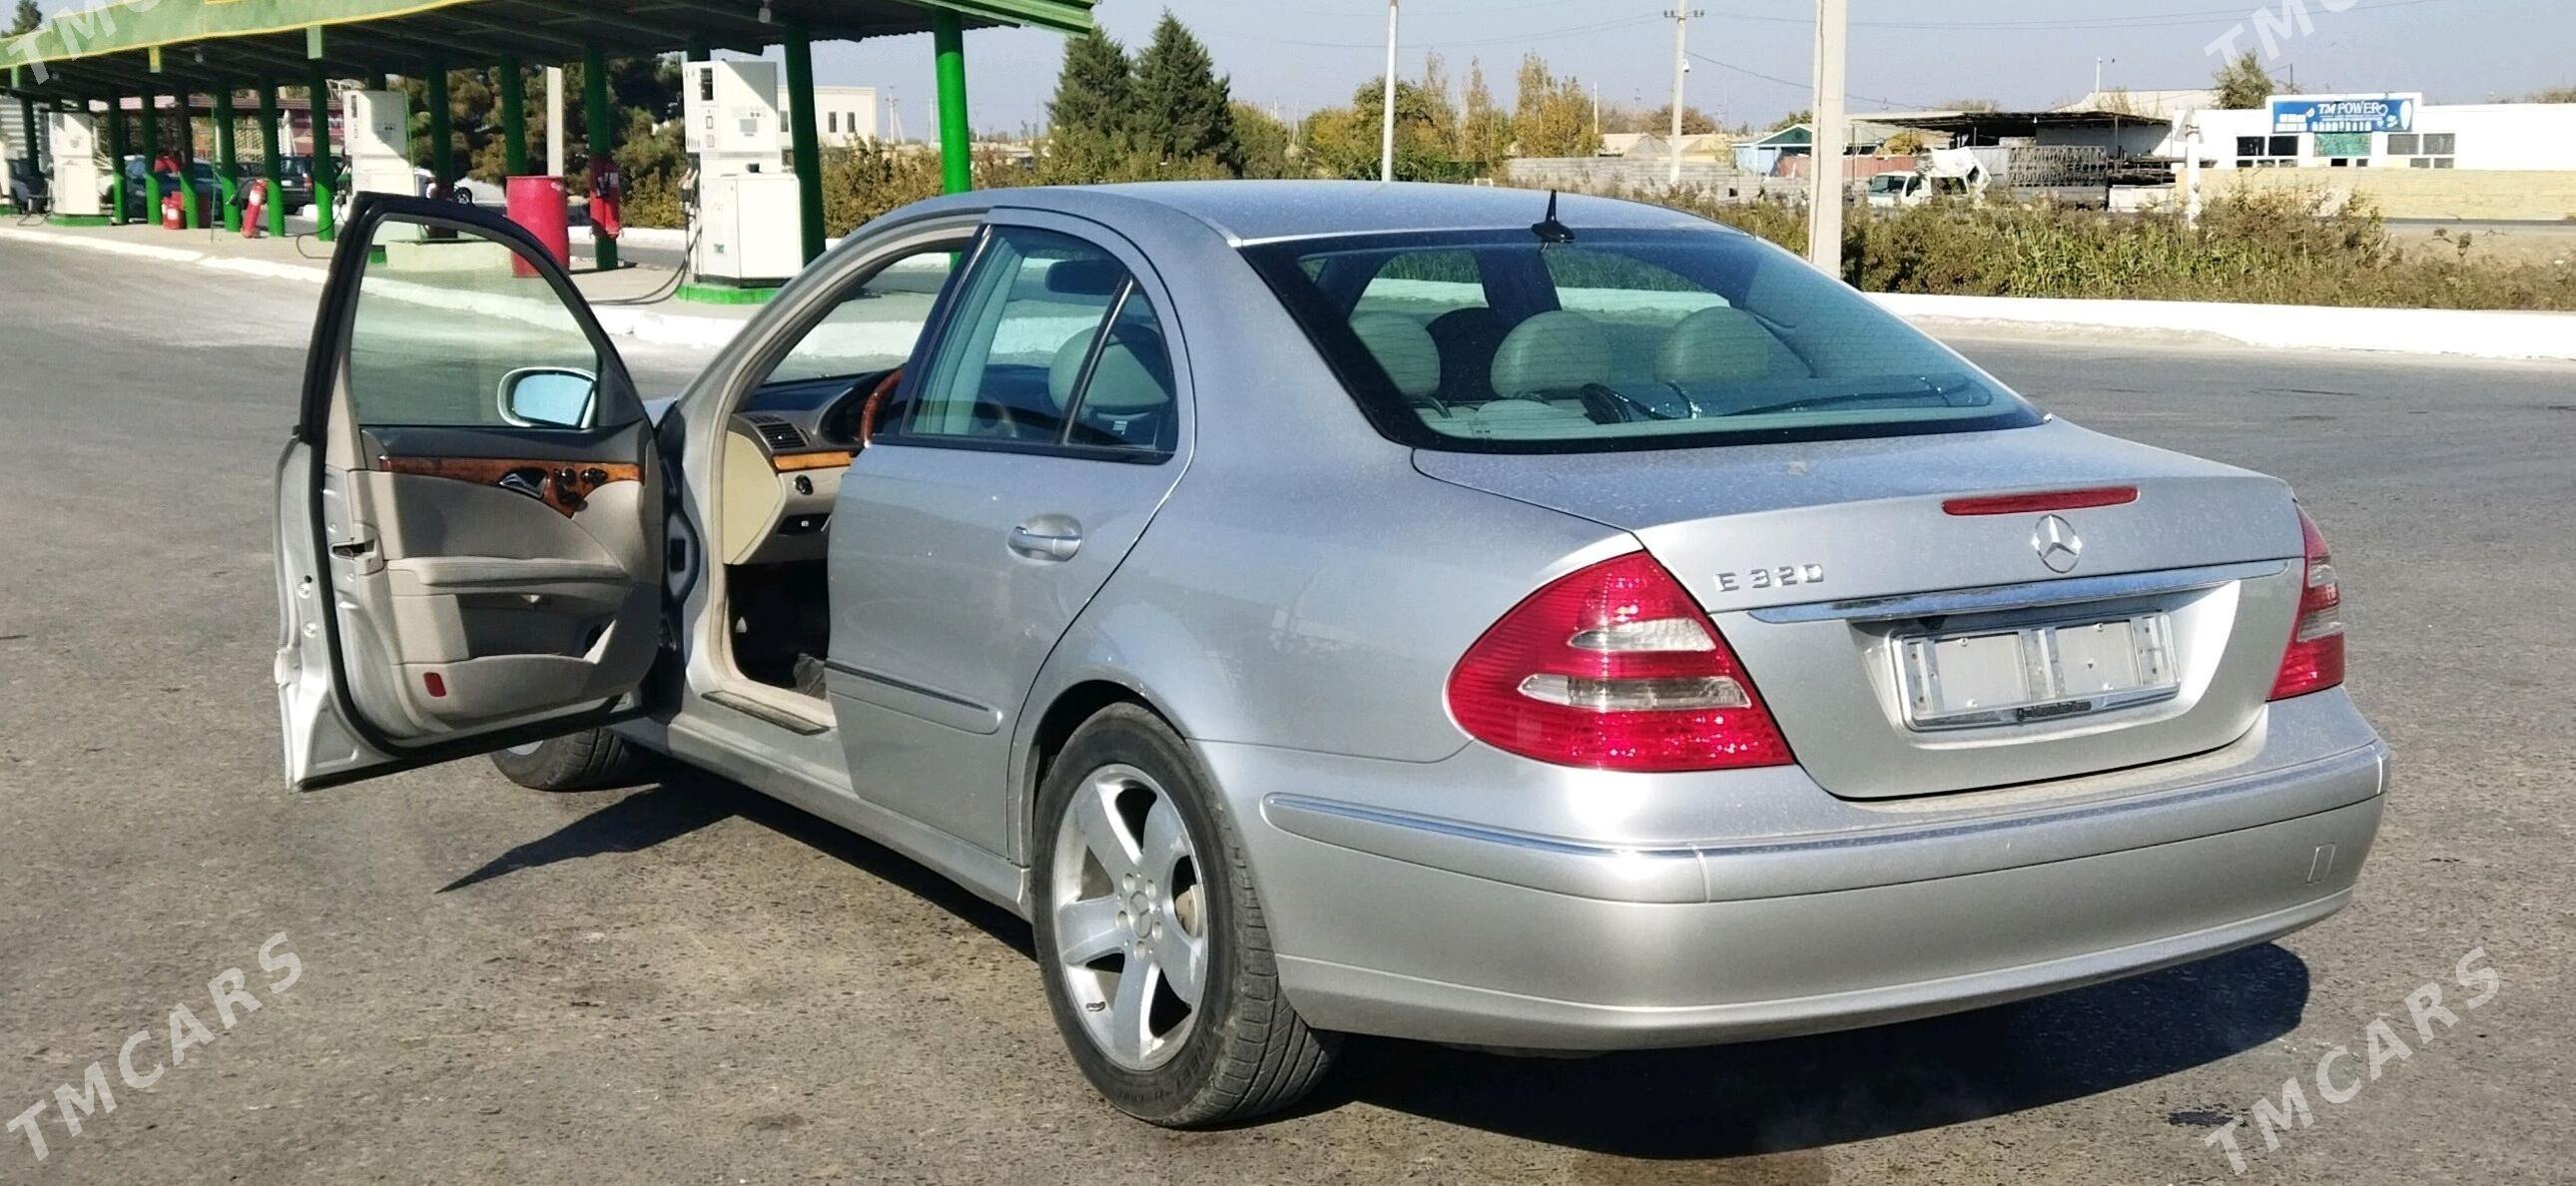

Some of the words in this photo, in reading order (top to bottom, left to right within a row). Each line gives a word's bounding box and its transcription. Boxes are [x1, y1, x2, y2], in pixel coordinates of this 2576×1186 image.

[2317, 103, 2336, 115] TM
[1713, 572, 1739, 592] E
[1748, 563, 1824, 589] 320
